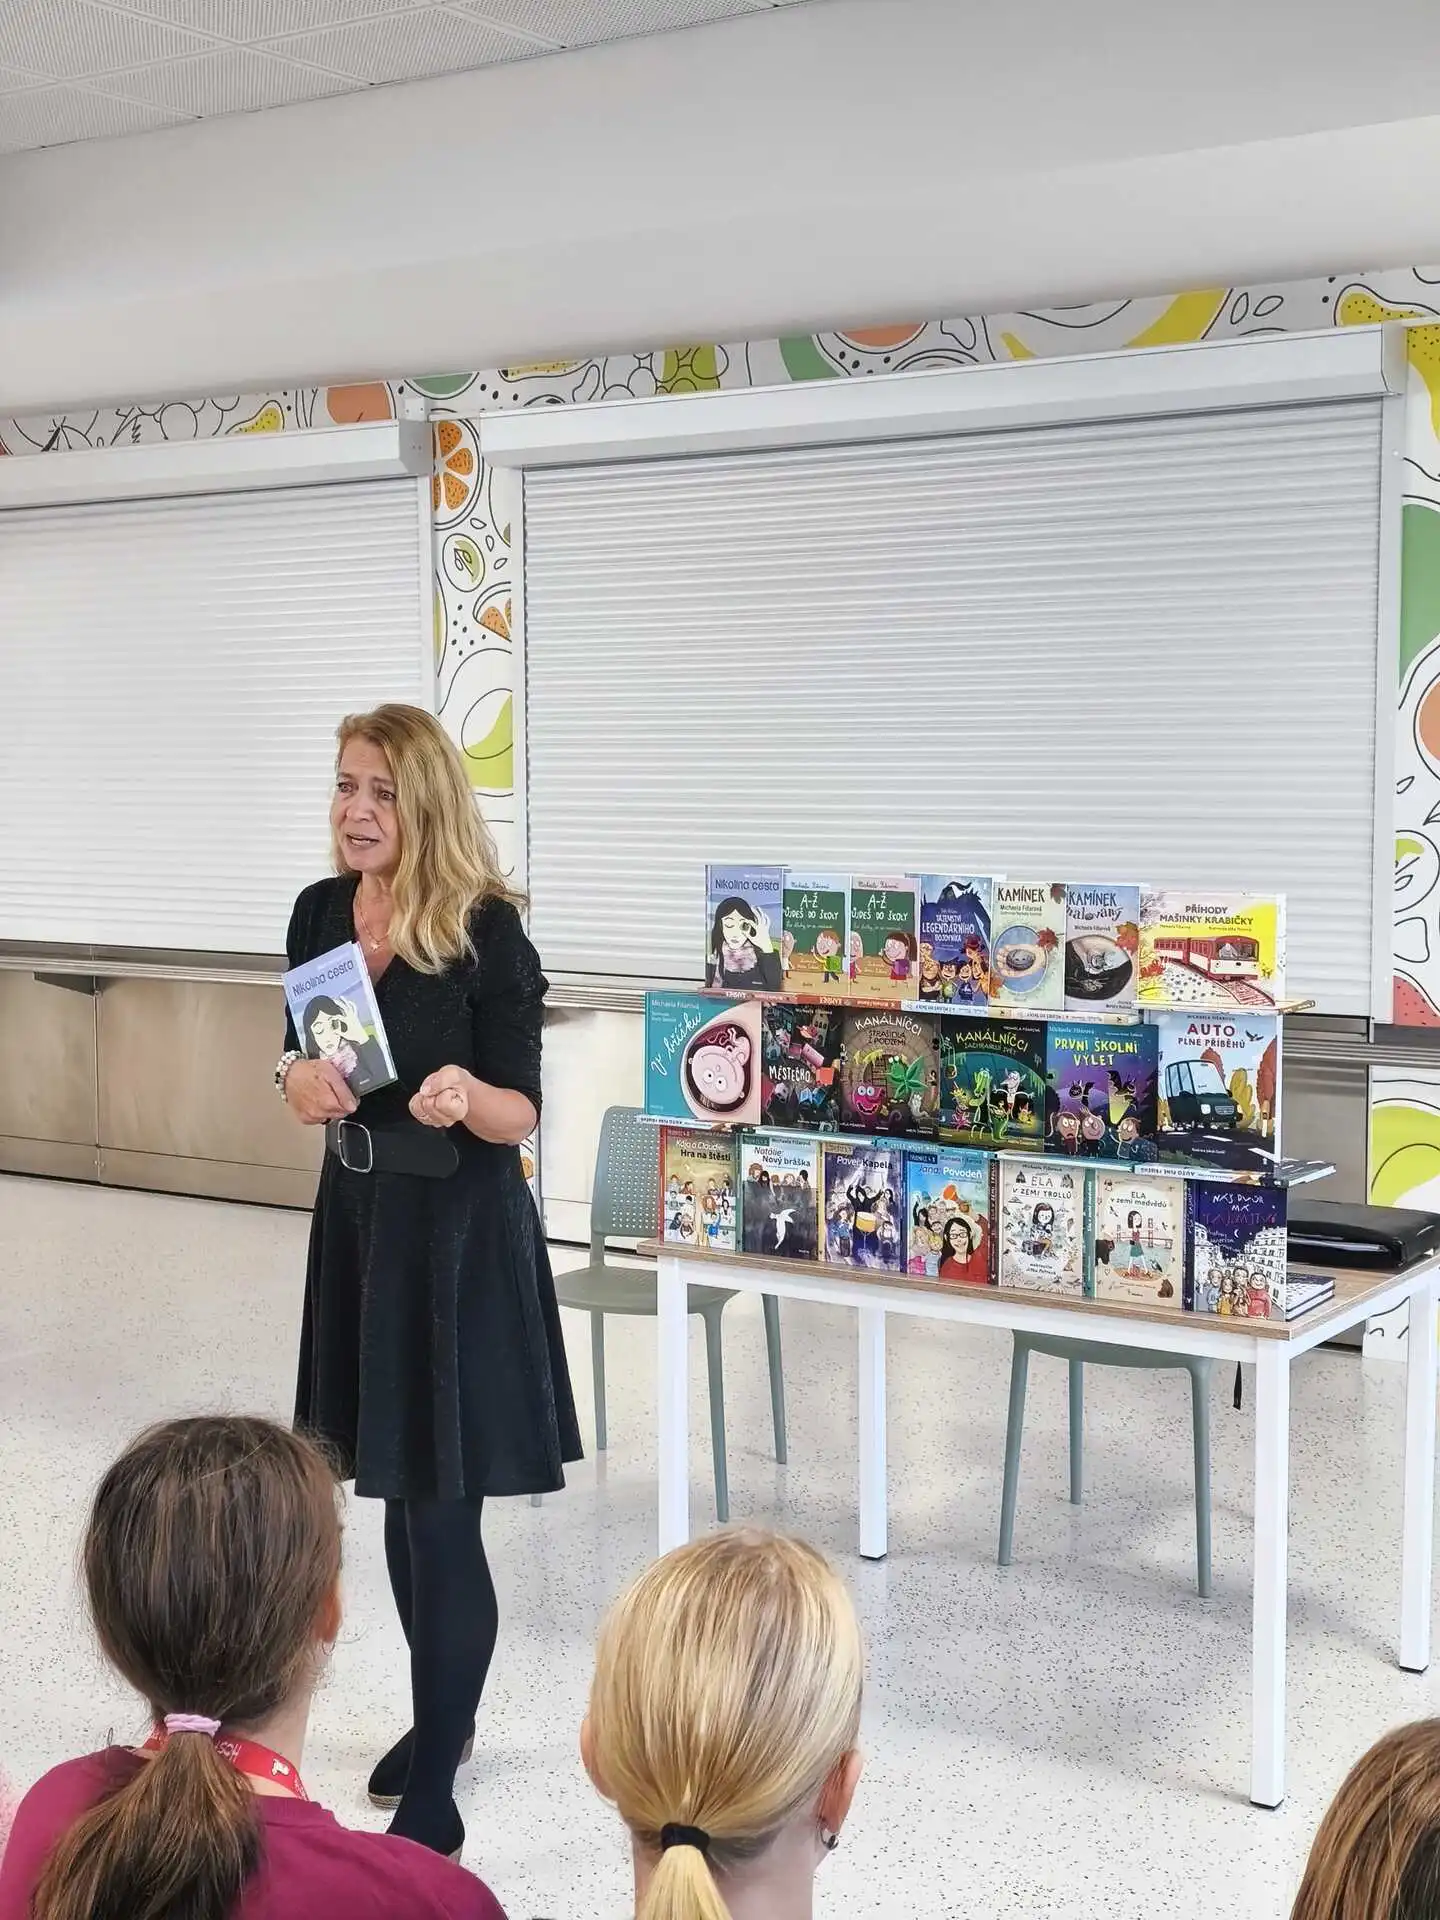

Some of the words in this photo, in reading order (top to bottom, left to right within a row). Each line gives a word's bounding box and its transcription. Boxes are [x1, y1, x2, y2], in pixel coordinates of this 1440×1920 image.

[715, 879, 750, 891] Nikolina
[752, 880, 779, 892] cesta
[800, 892, 818, 908] A-Ž
[867, 892, 887, 909] A-Ž
[997, 886, 1045, 904] KAMÍNEK
[1069, 889, 1117, 908] KAMÍNEK
[783, 907, 804, 919] ŮJDEŠ
[808, 910, 816, 919] DO
[819, 907, 839, 921] ŠKOLY
[851, 907, 872, 920] ŮJDEŠ
[876, 911, 884, 920] DO
[888, 909, 908, 922] ŠKOLY
[1185, 903, 1228, 915] PŘÍHODY
[1159, 913, 1202, 924] MAŠINKY
[1205, 915, 1254, 926] KRABIČKY
[922, 921, 975, 935] LEGENDÁRNÍHO
[291, 973, 327, 998] Nikolina
[328, 959, 355, 981] cesta
[855, 1012, 922, 1036] KANÁLNÍČCI
[1187, 1023, 1236, 1038] AUTO
[955, 1027, 1028, 1053] KANÁLNÍČCI
[1054, 1037, 1088, 1052] PRVNÍ
[1094, 1037, 1138, 1055] ŠKOLNÍ
[1178, 1037, 1202, 1047] PLNÉ
[1205, 1038, 1246, 1050] PŘÍBĚHŮ
[1073, 1052, 1115, 1067] VÝLET
[769, 1065, 811, 1084] MĚSTEČKO
[680, 1149, 695, 1159] Hra
[696, 1152, 706, 1160] na
[708, 1151, 731, 1163] štěstí
[762, 1155, 782, 1166] Nový
[784, 1157, 811, 1168] bráška
[862, 1156, 893, 1171] Kapela
[943, 1166, 983, 1180] Povodeň
[1031, 1175, 1054, 1188] ELA
[1020, 1188, 1041, 1197] ZEMI
[1043, 1190, 1072, 1200] TROLLŮ
[1131, 1190, 1146, 1200] ELA
[1135, 1199, 1167, 1209] medvědů
